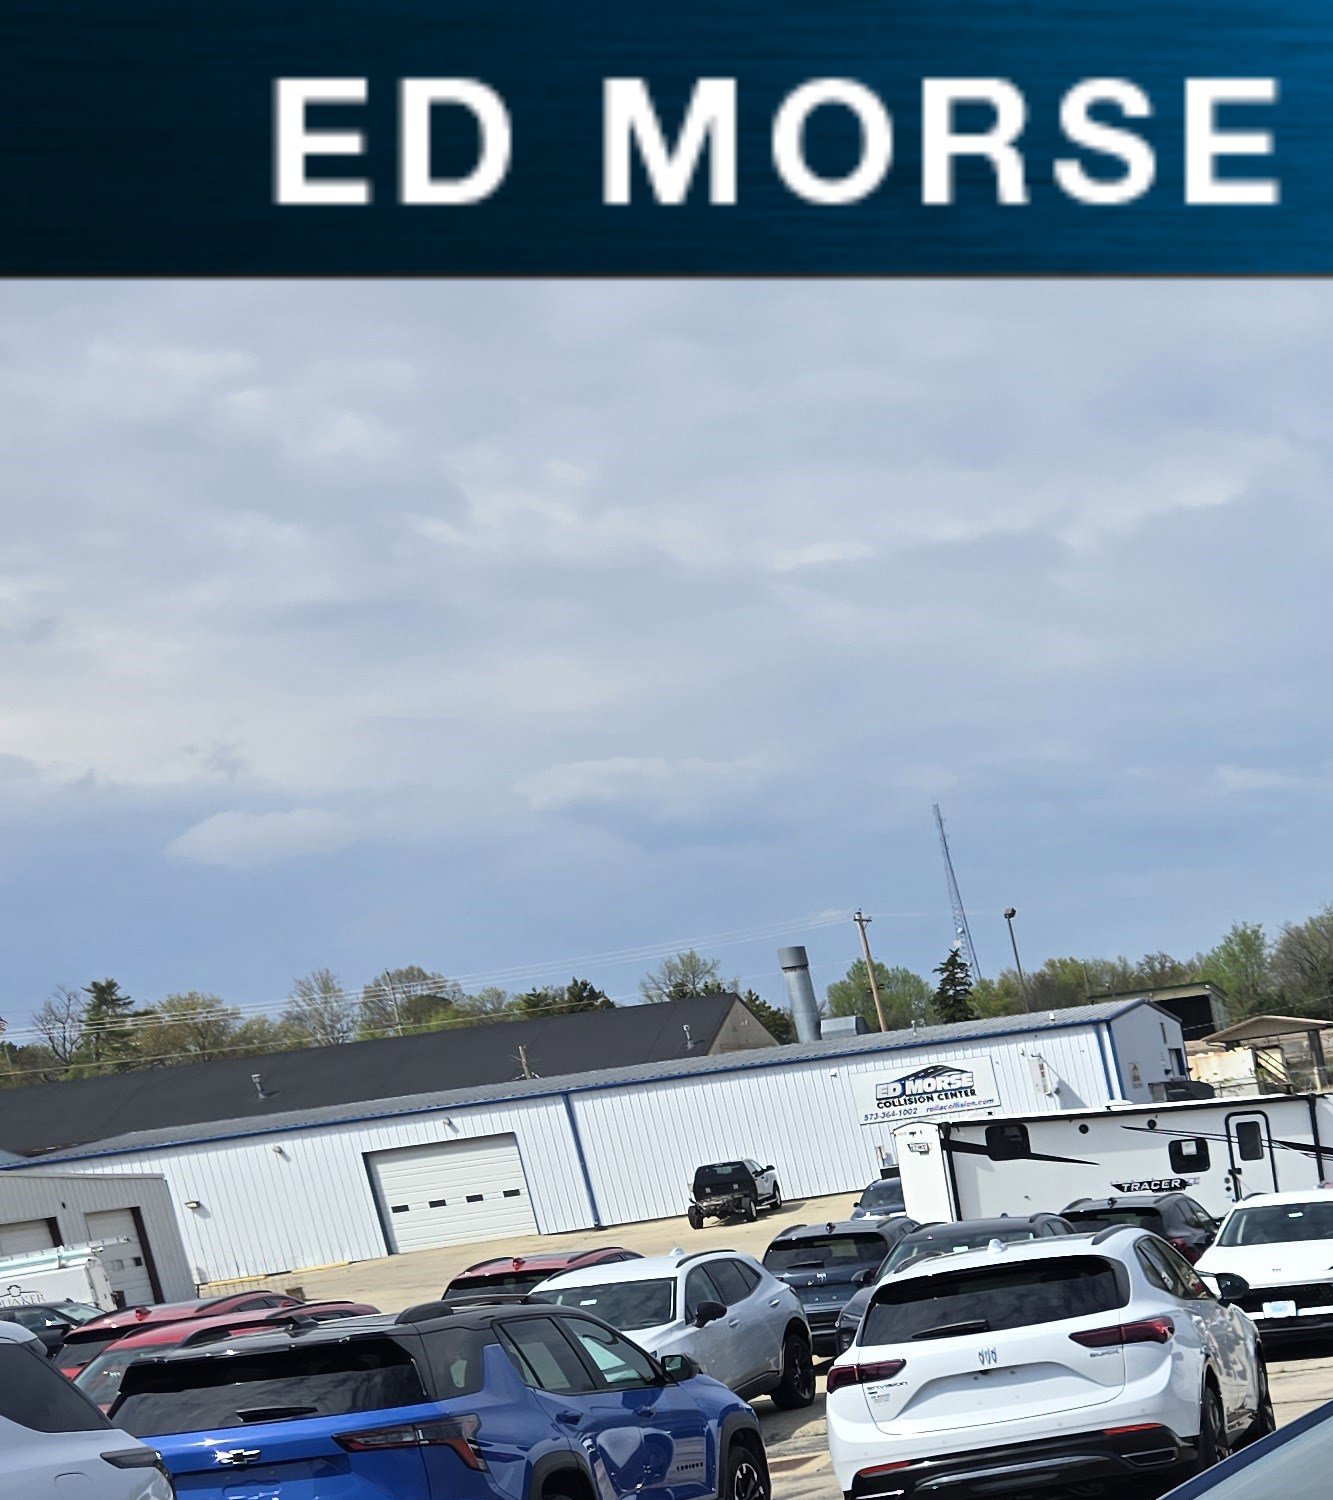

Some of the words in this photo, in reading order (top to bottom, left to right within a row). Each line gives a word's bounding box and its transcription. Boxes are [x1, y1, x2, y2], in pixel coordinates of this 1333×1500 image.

[876, 1081, 903, 1101] ED
[904, 1072, 975, 1096] MORSE
[876, 1094, 935, 1109] COLLISION
[937, 1088, 977, 1101] CENTER
[864, 1108, 918, 1121] 573-364-1002
[1121, 1179, 1181, 1192] TRACER
